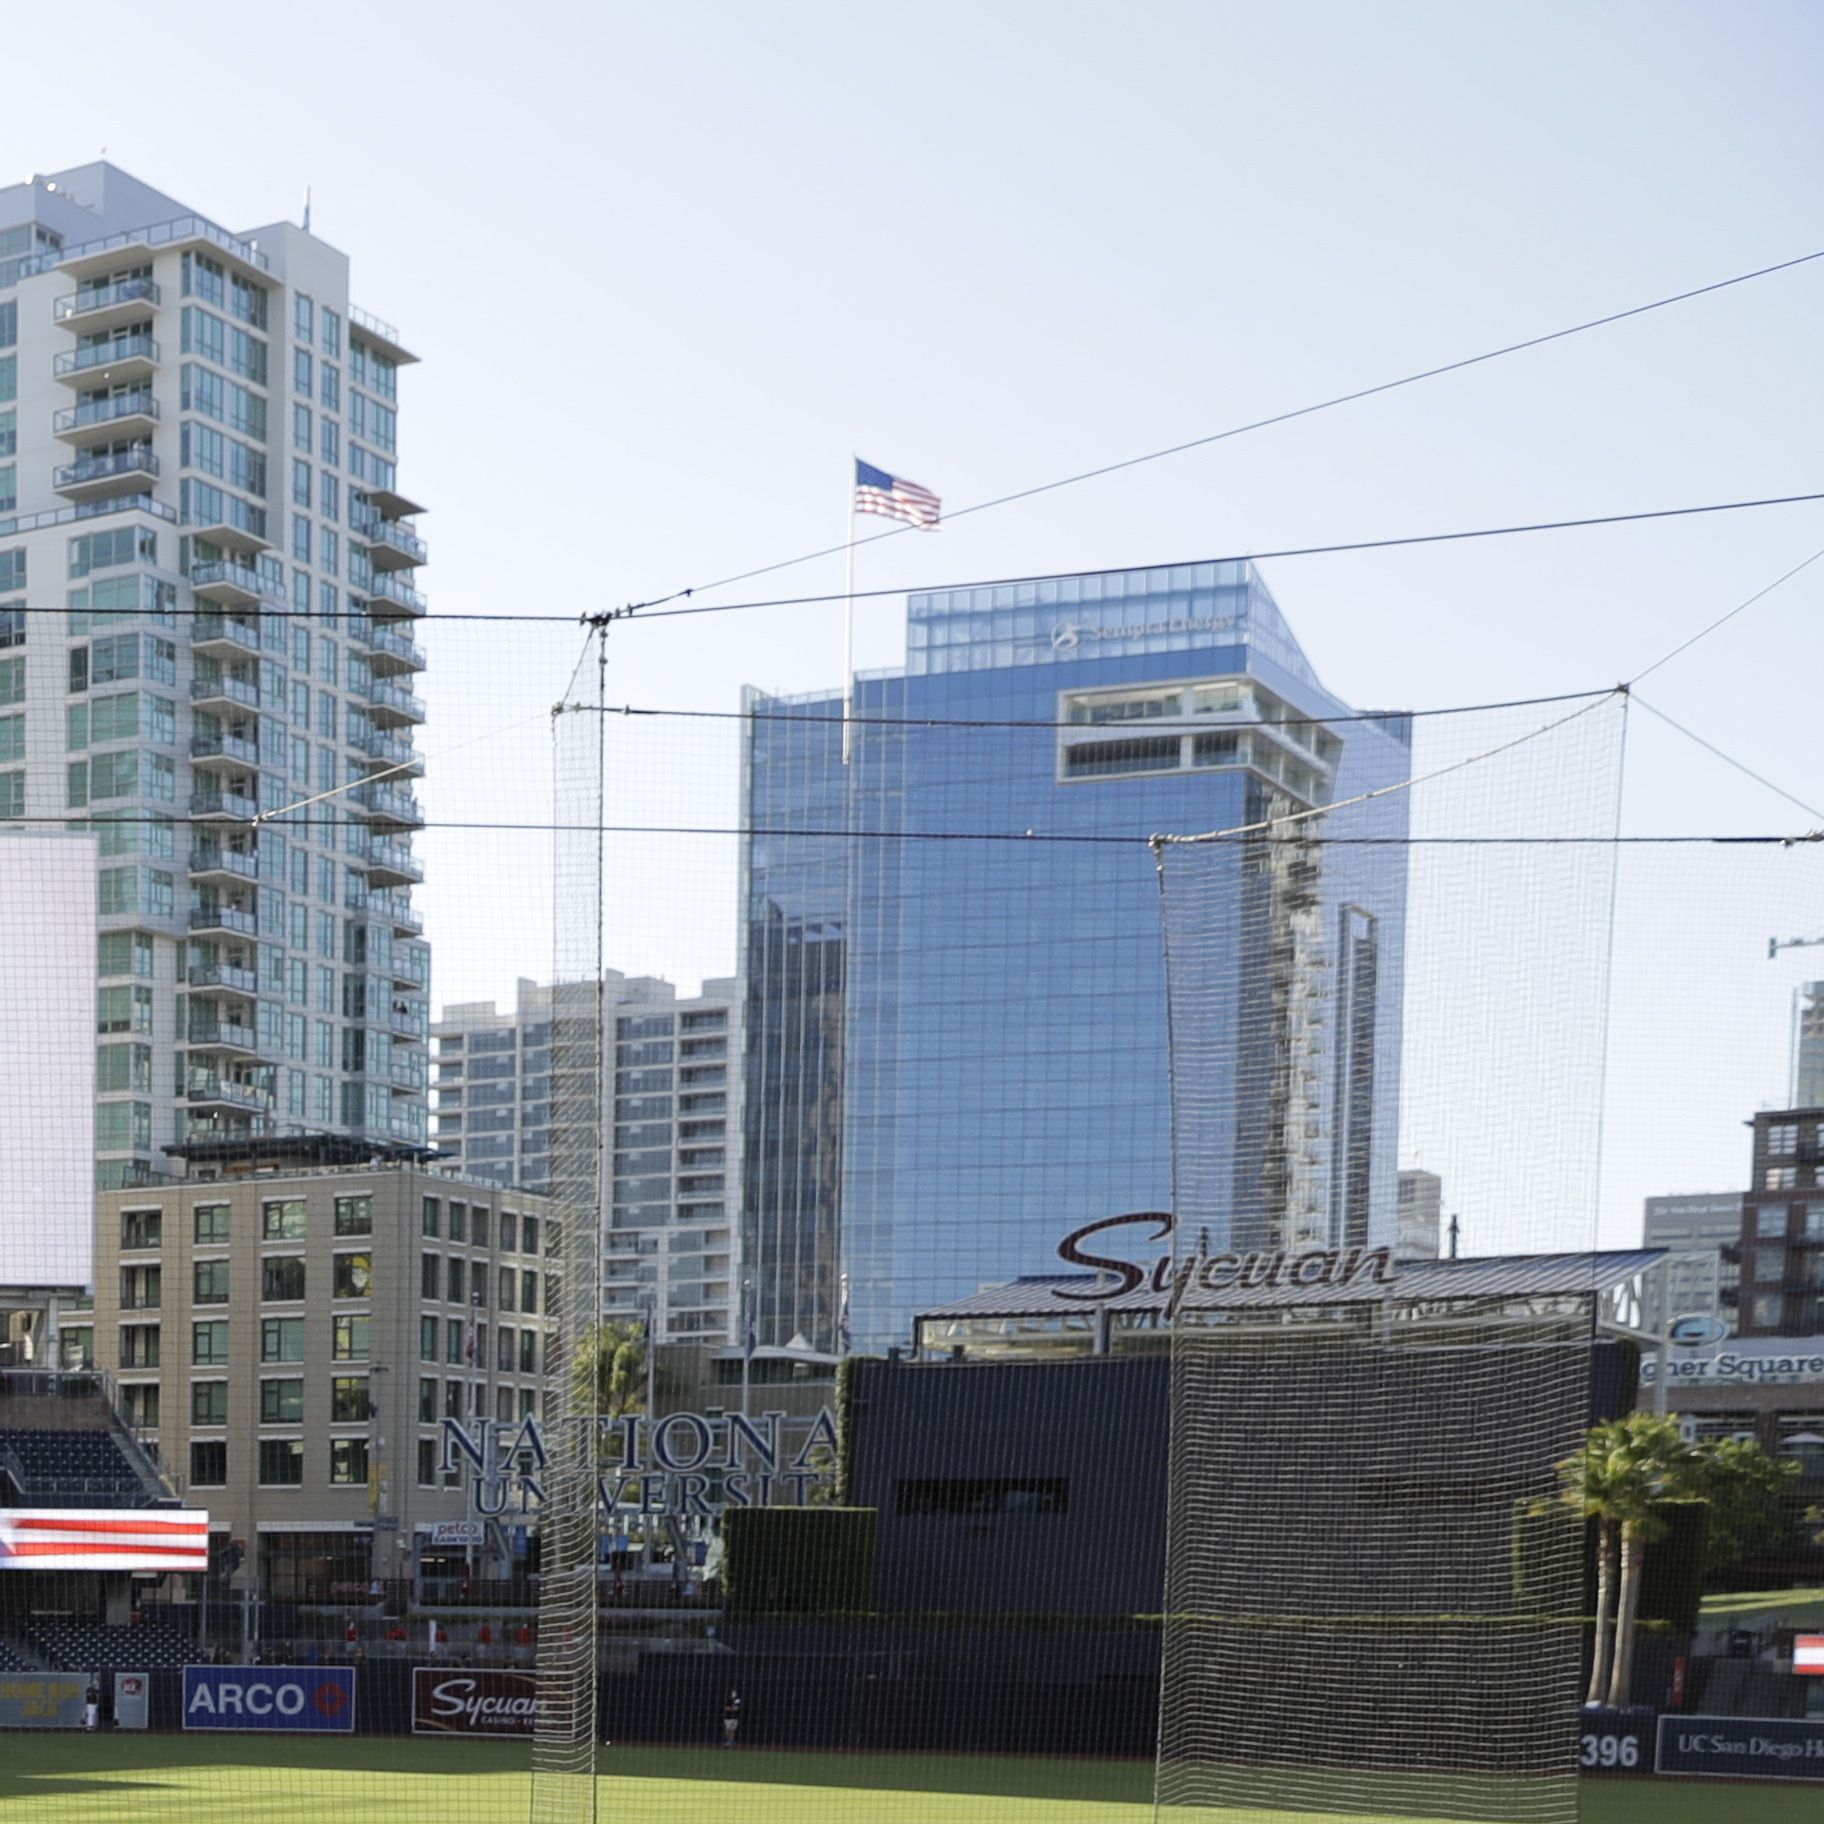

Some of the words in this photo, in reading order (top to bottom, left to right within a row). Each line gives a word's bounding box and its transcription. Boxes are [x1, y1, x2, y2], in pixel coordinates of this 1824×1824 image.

[1051, 1211, 1405, 1321] Sycuan
[1718, 1354, 1824, 1380] Square
[438, 1405, 839, 1472] NATIONA
[188, 1683, 305, 1715] ARCO
[1580, 1734, 1639, 1767] 396
[1678, 1733, 1709, 1754] UC
[1710, 1734, 1745, 1755] San
[1749, 1737, 1803, 1761] Diego
